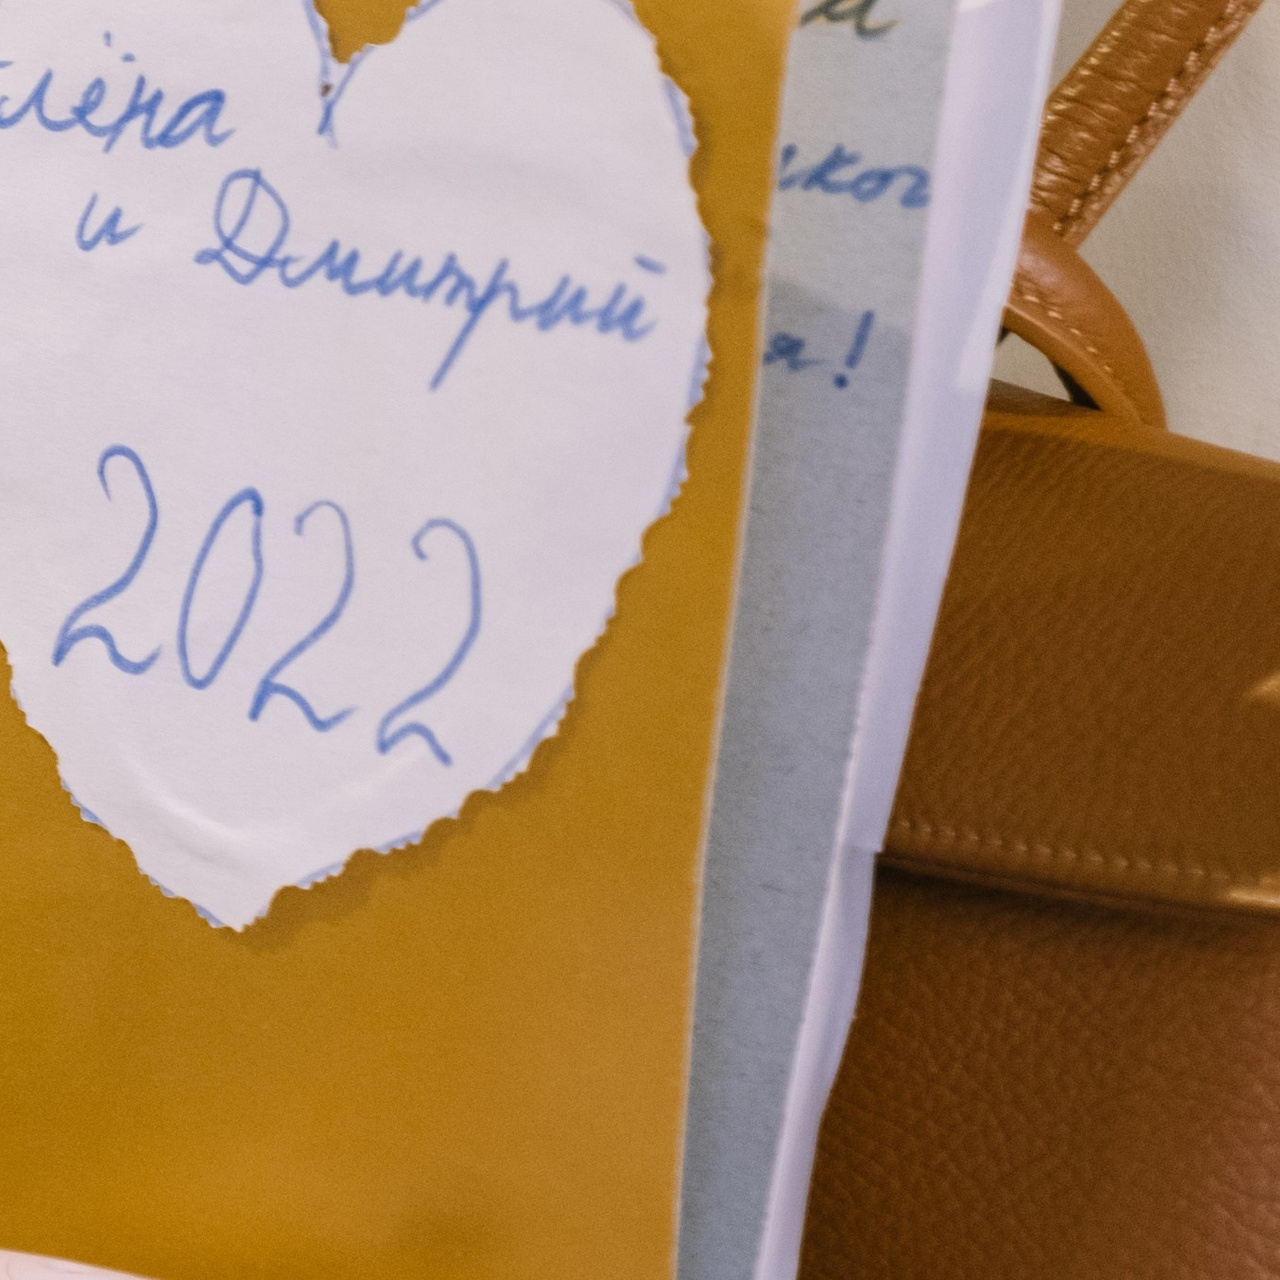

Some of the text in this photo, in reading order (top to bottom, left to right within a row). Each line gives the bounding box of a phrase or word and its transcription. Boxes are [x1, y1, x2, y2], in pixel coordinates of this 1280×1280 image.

[77, 169, 666, 390] и Дмитрий
[52, 445, 482, 766] 2022
